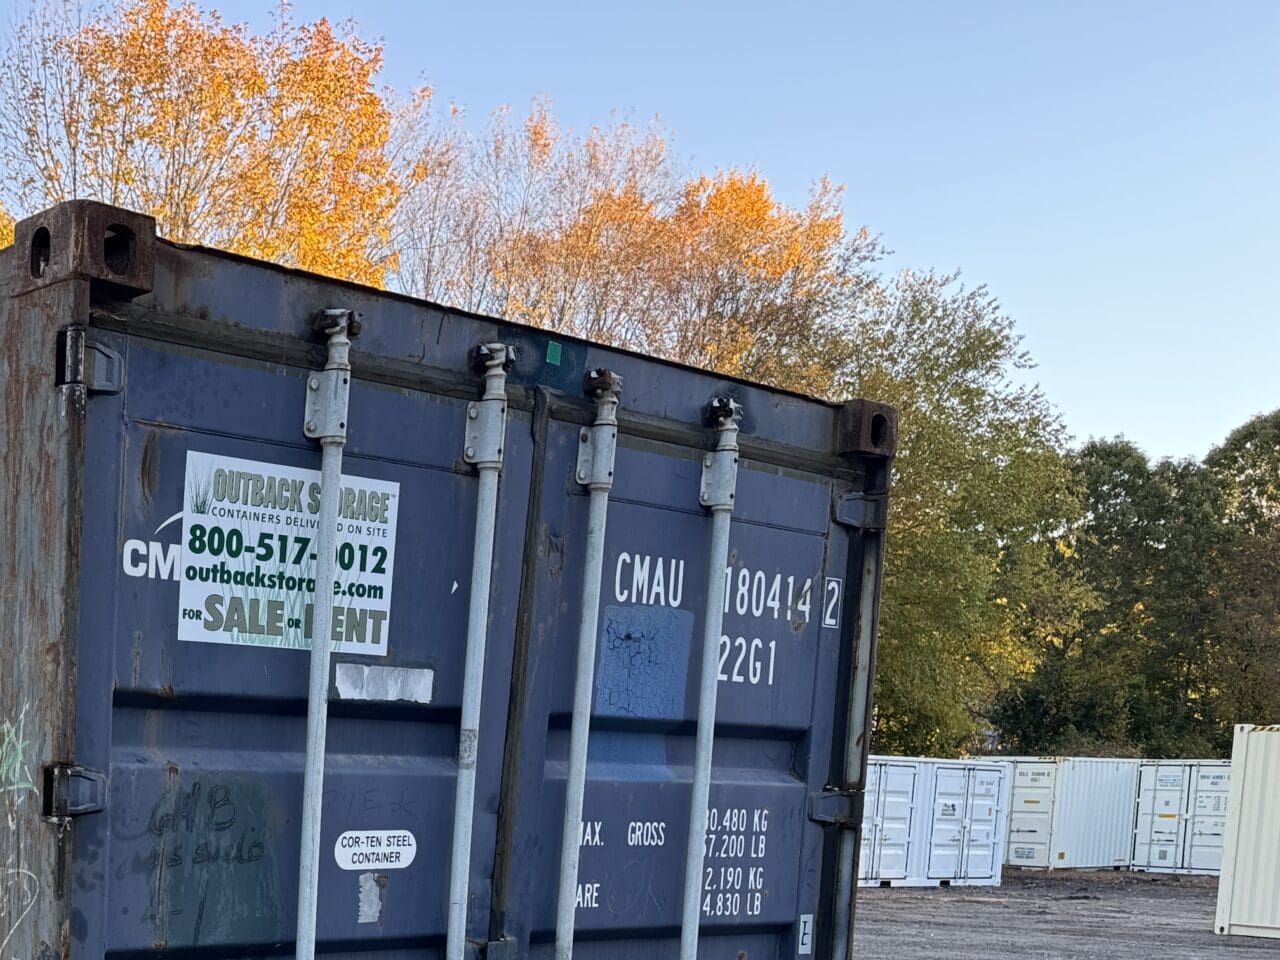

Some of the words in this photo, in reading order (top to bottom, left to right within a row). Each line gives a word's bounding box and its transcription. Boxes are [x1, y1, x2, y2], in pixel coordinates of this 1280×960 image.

[213, 468, 305, 513] OUTBACK
[307, 482, 390, 524] SRAGE
[211, 506, 281, 525] CONTAINERS
[347, 524, 362, 534] ON
[366, 526, 388, 538] SITE
[188, 524, 388, 575] 800-517-012
[185, 562, 384, 600] outbackstorae.com
[615, 552, 684, 608] CMAU
[824, 580, 841, 626] 2
[182, 608, 202, 620] FOR
[203, 593, 284, 636] SALE
[287, 618, 301, 628] OR
[718, 635, 776, 685] 22G1
[753, 809, 769, 832] KG
[341, 836, 382, 848] COR-TEN
[386, 835, 412, 847] STEEL
[628, 821, 666, 846] GROSS
[751, 834, 766, 857] LB
[351, 851, 401, 864] CONTAINER
[704, 867, 742, 890] 2,190
[748, 867, 763, 890] KG
[574, 883, 600, 908] ARE
[702, 893, 740, 916] 4,830
[747, 893, 761, 915] LB
